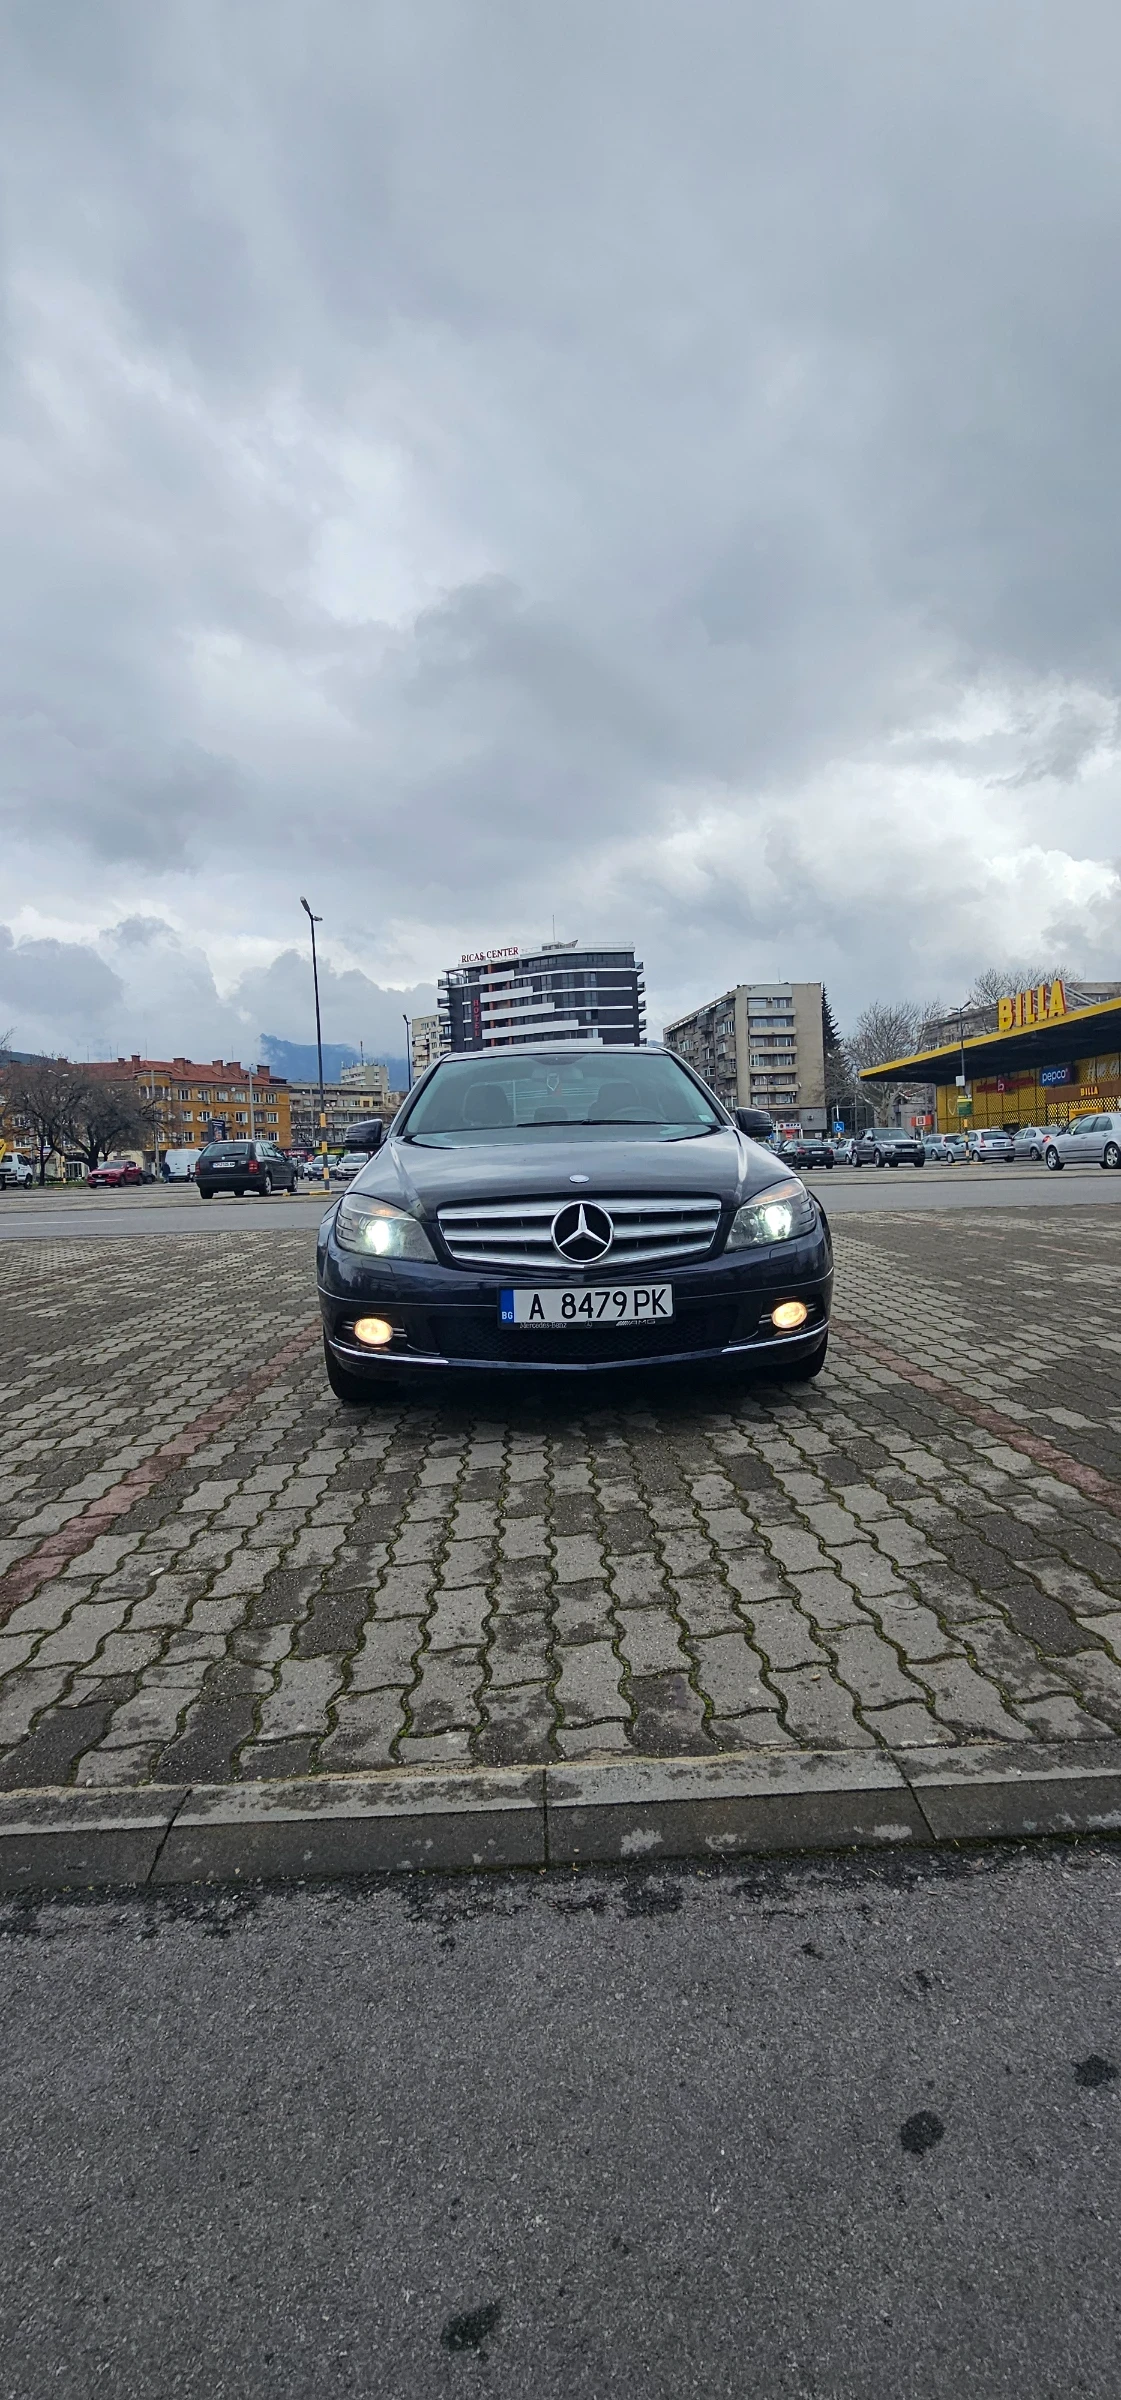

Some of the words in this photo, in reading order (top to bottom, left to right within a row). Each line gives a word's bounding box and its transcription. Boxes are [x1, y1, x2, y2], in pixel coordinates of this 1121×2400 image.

[461, 952, 486, 963] RICAS
[486, 946, 519, 959] CENTER
[998, 979, 1066, 1032] BILLA
[1041, 1069, 1066, 1084] pepco
[1080, 1086, 1099, 1097] BILLA
[529, 1293, 545, 1320] A
[502, 1311, 513, 1320] BG
[519, 1321, 567, 1329] Mercedes-Benz
